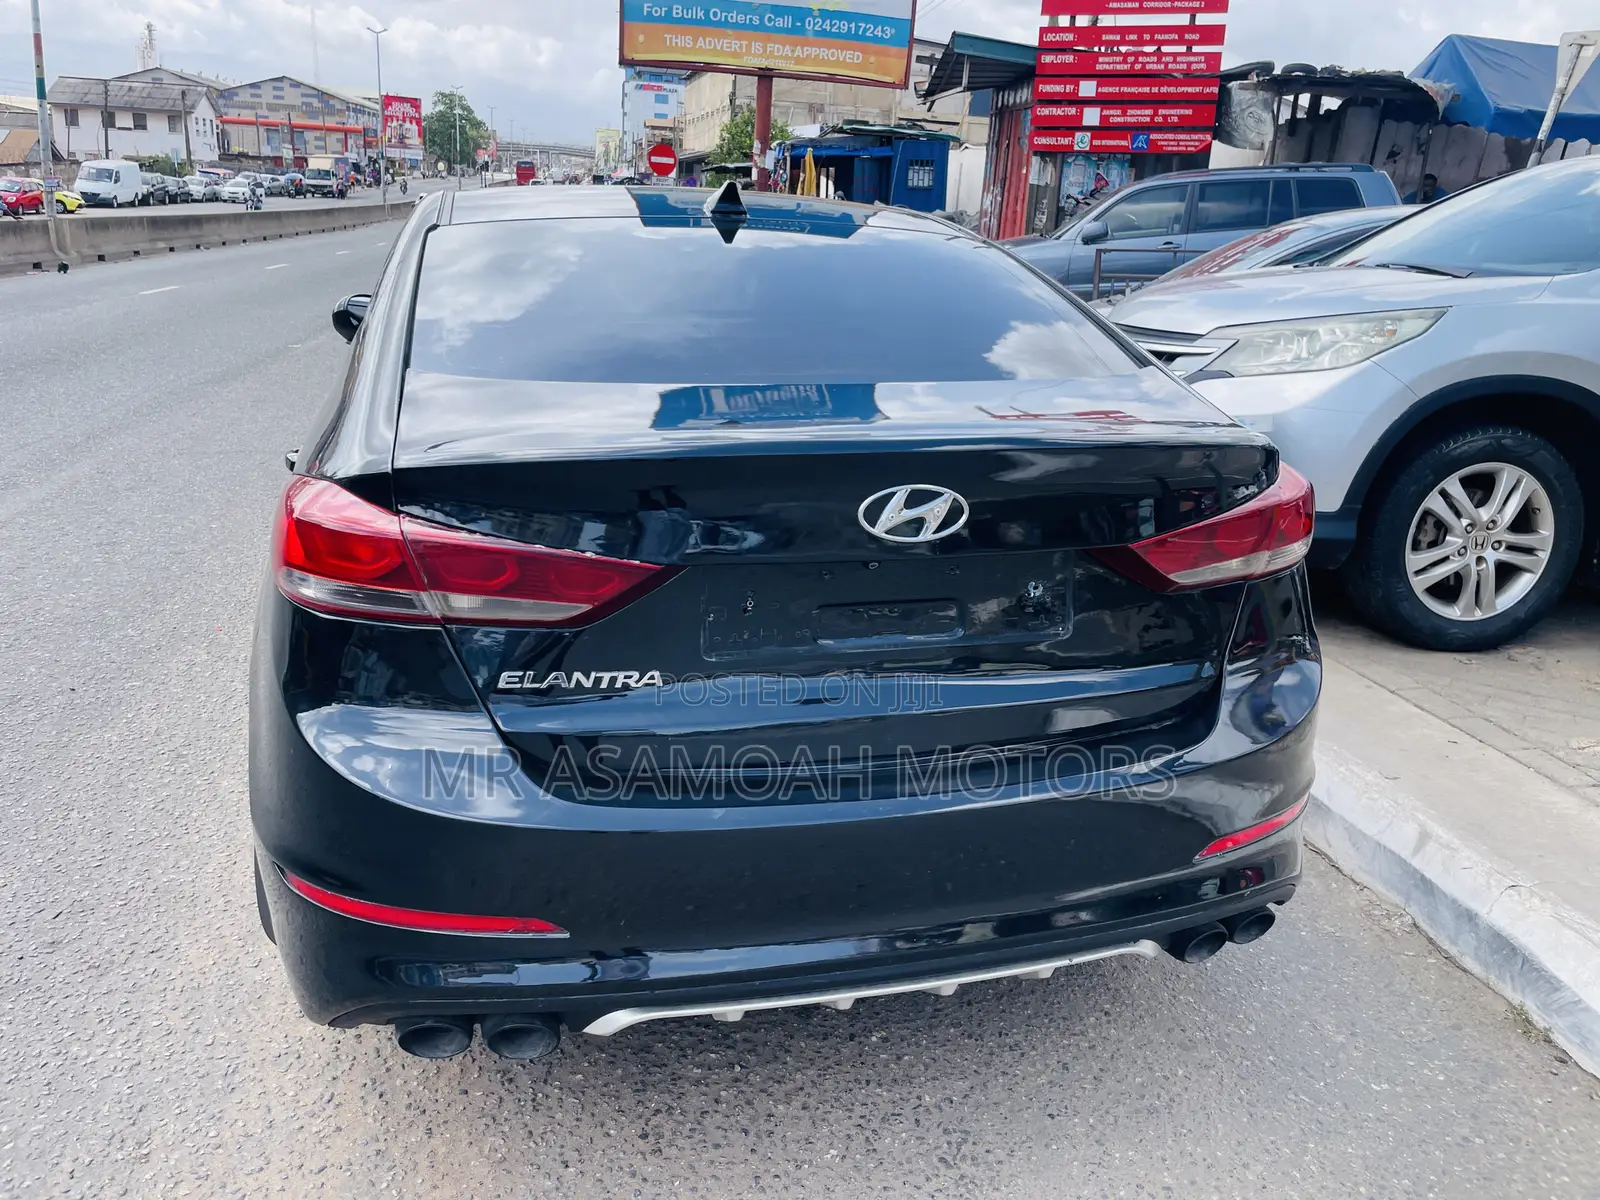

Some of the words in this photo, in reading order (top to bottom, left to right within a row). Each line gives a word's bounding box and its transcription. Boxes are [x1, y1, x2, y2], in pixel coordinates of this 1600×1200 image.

[643, 3, 668, 16] For
[672, 5, 705, 20] Bulk
[709, 8, 760, 25] Orders
[765, 14, 792, 28] Call
[664, 34, 693, 48] THIS
[695, 37, 749, 53] ADVERT
[751, 42, 763, 54] IS
[766, 44, 791, 57] FDA
[793, 45, 863, 63] APPROVED
[1038, 84, 1065, 93] FUNDING
[497, 670, 663, 689] ELANTRA
